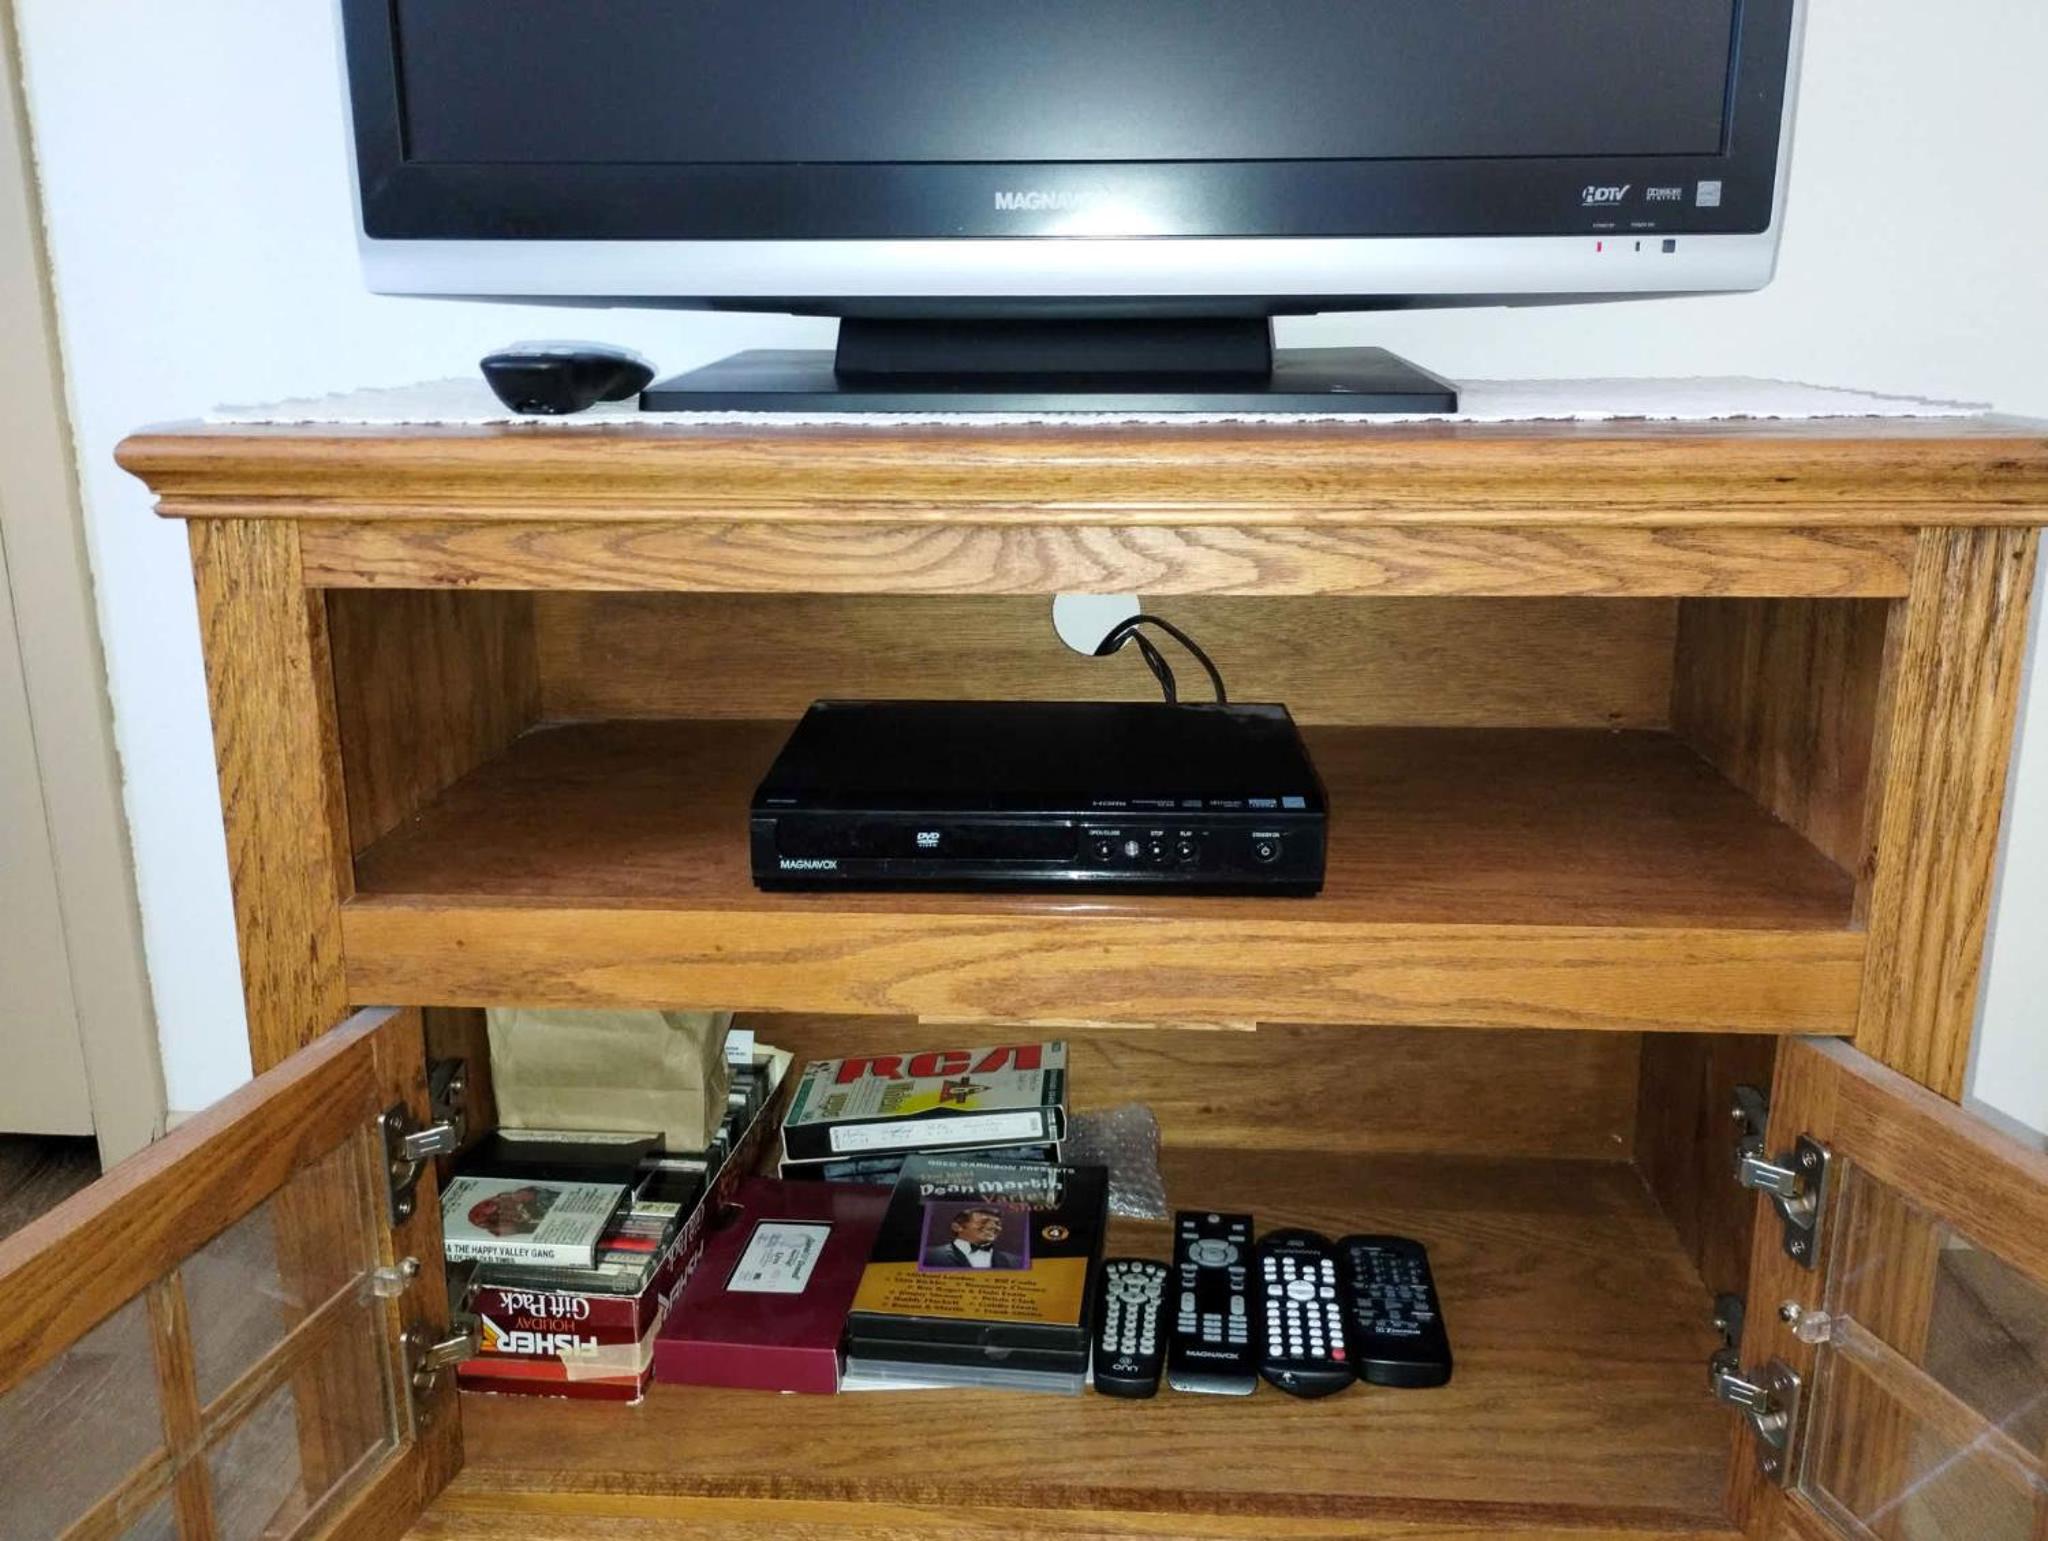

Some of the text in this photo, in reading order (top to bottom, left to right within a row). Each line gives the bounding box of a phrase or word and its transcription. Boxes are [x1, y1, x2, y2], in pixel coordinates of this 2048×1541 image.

[916, 832, 940, 842] DVD
[779, 860, 838, 870] MAGNAVOX
[836, 1044, 1042, 1084] RCA
[920, 1178, 1064, 1196] Dean Martin
[455, 1244, 469, 1254] THE
[472, 1245, 498, 1256] HAPPY
[500, 1247, 529, 1258] VALLEY
[531, 1250, 555, 1259] GANG
[500, 1291, 591, 1321] Gift Pack
[516, 1317, 576, 1332] HOLIDAY
[483, 1322, 598, 1357] FISHER
[1112, 1363, 1139, 1373] onn
